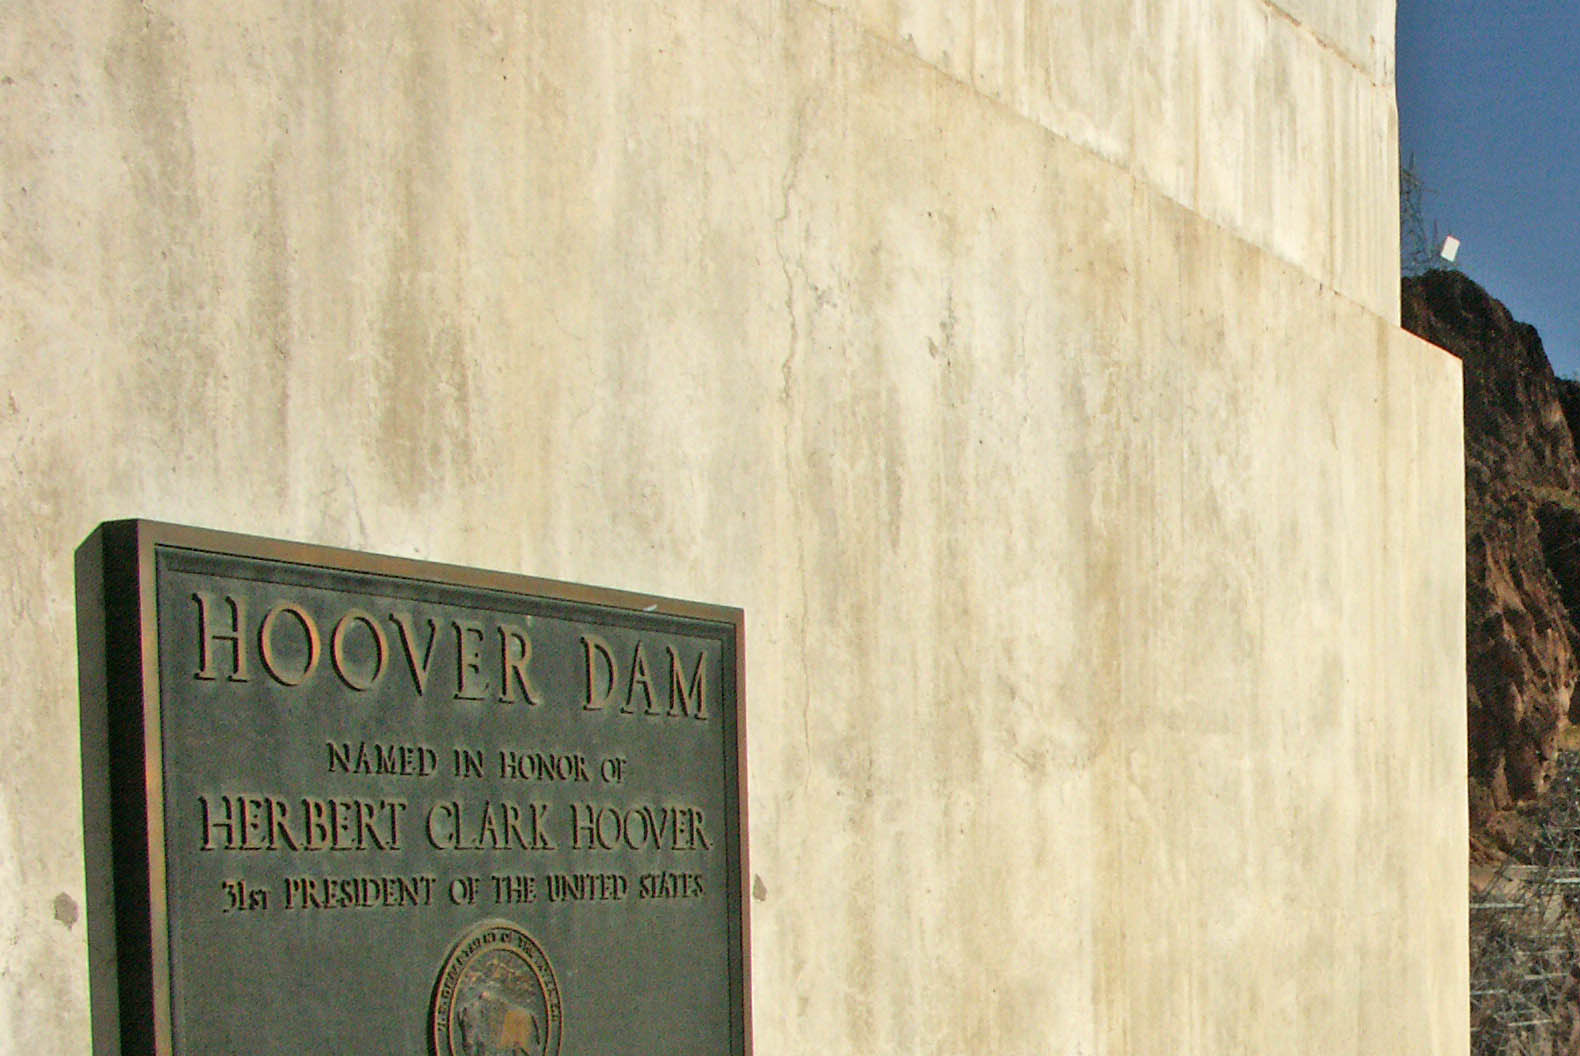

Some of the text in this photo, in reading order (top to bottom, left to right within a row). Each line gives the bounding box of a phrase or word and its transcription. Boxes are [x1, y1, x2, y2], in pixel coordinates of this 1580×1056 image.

[191, 592, 708, 721] HOOVER DAM
[326, 741, 628, 784] NAMED IN HONOR OF
[198, 795, 712, 852] HERBERT CLARK HOOVER
[285, 876, 437, 910] PRESIDENT
[449, 874, 481, 905] OF
[491, 874, 537, 904] THE
[546, 873, 629, 902] UNITED
[640, 871, 705, 900] STATES
